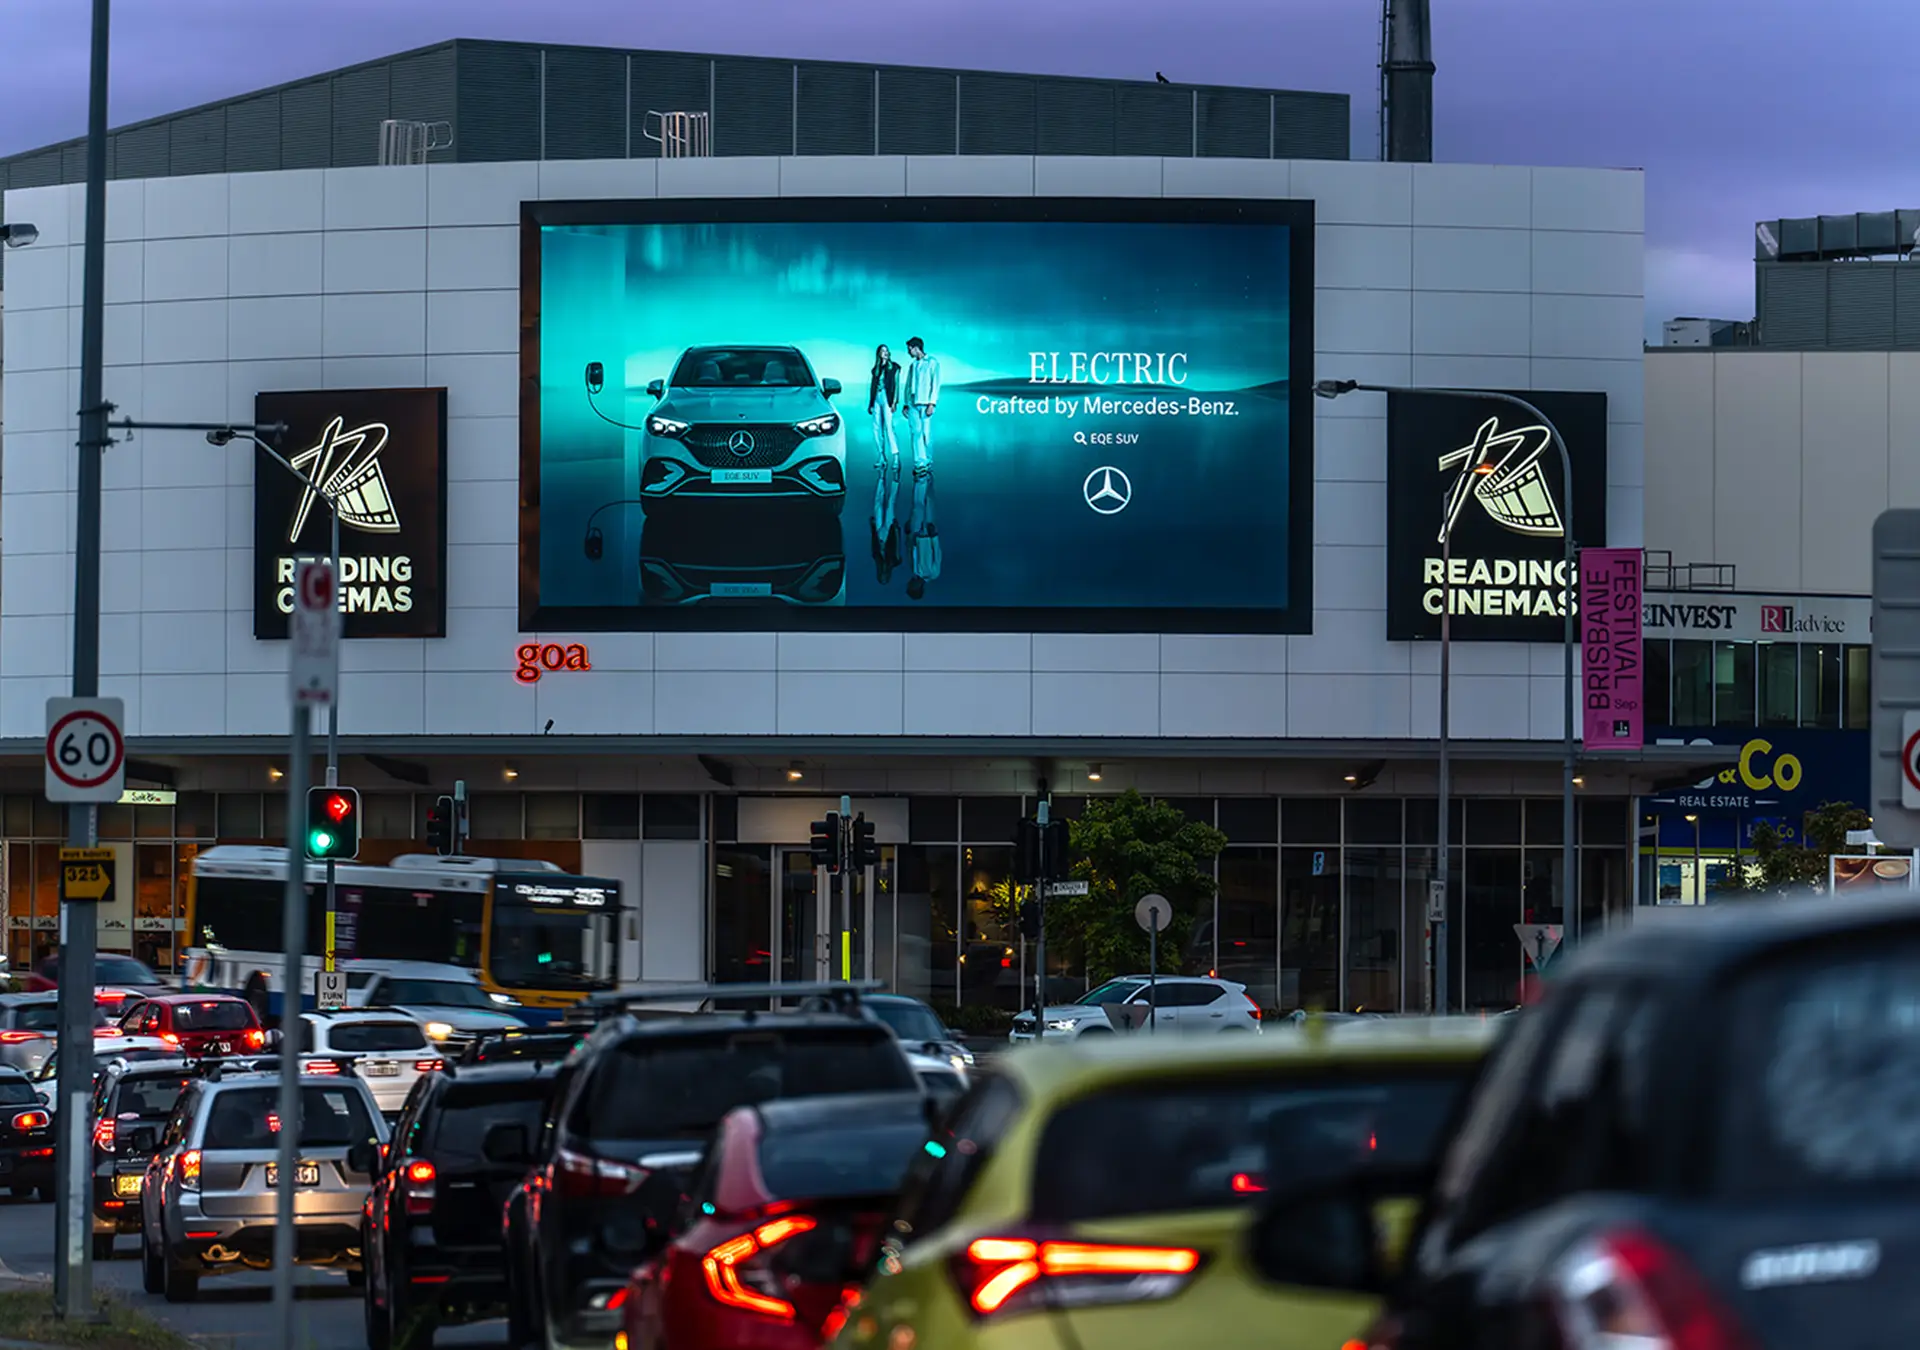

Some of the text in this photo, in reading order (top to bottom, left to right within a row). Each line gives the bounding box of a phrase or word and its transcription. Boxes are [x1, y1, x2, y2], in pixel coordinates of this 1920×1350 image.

[1028, 352, 1188, 385] ELECTRIC
[976, 396, 1240, 418] Crafted by Mercedes-Benz.
[1090, 433, 1139, 446] EQE SUV
[1423, 558, 1578, 587] READING
[277, 585, 413, 614] CEMAS
[1422, 588, 1578, 617] CINEMAS
[1613, 559, 1637, 690] FESTIVAL
[1586, 569, 1610, 710] BRISBANE
[516, 642, 591, 683] goa
[1614, 698, 1638, 711] Sep
[59, 732, 111, 766] 60
[1679, 796, 1750, 808] REAL ESTATE
[322, 991, 344, 1000] TURN
[326, 975, 338, 990] U
